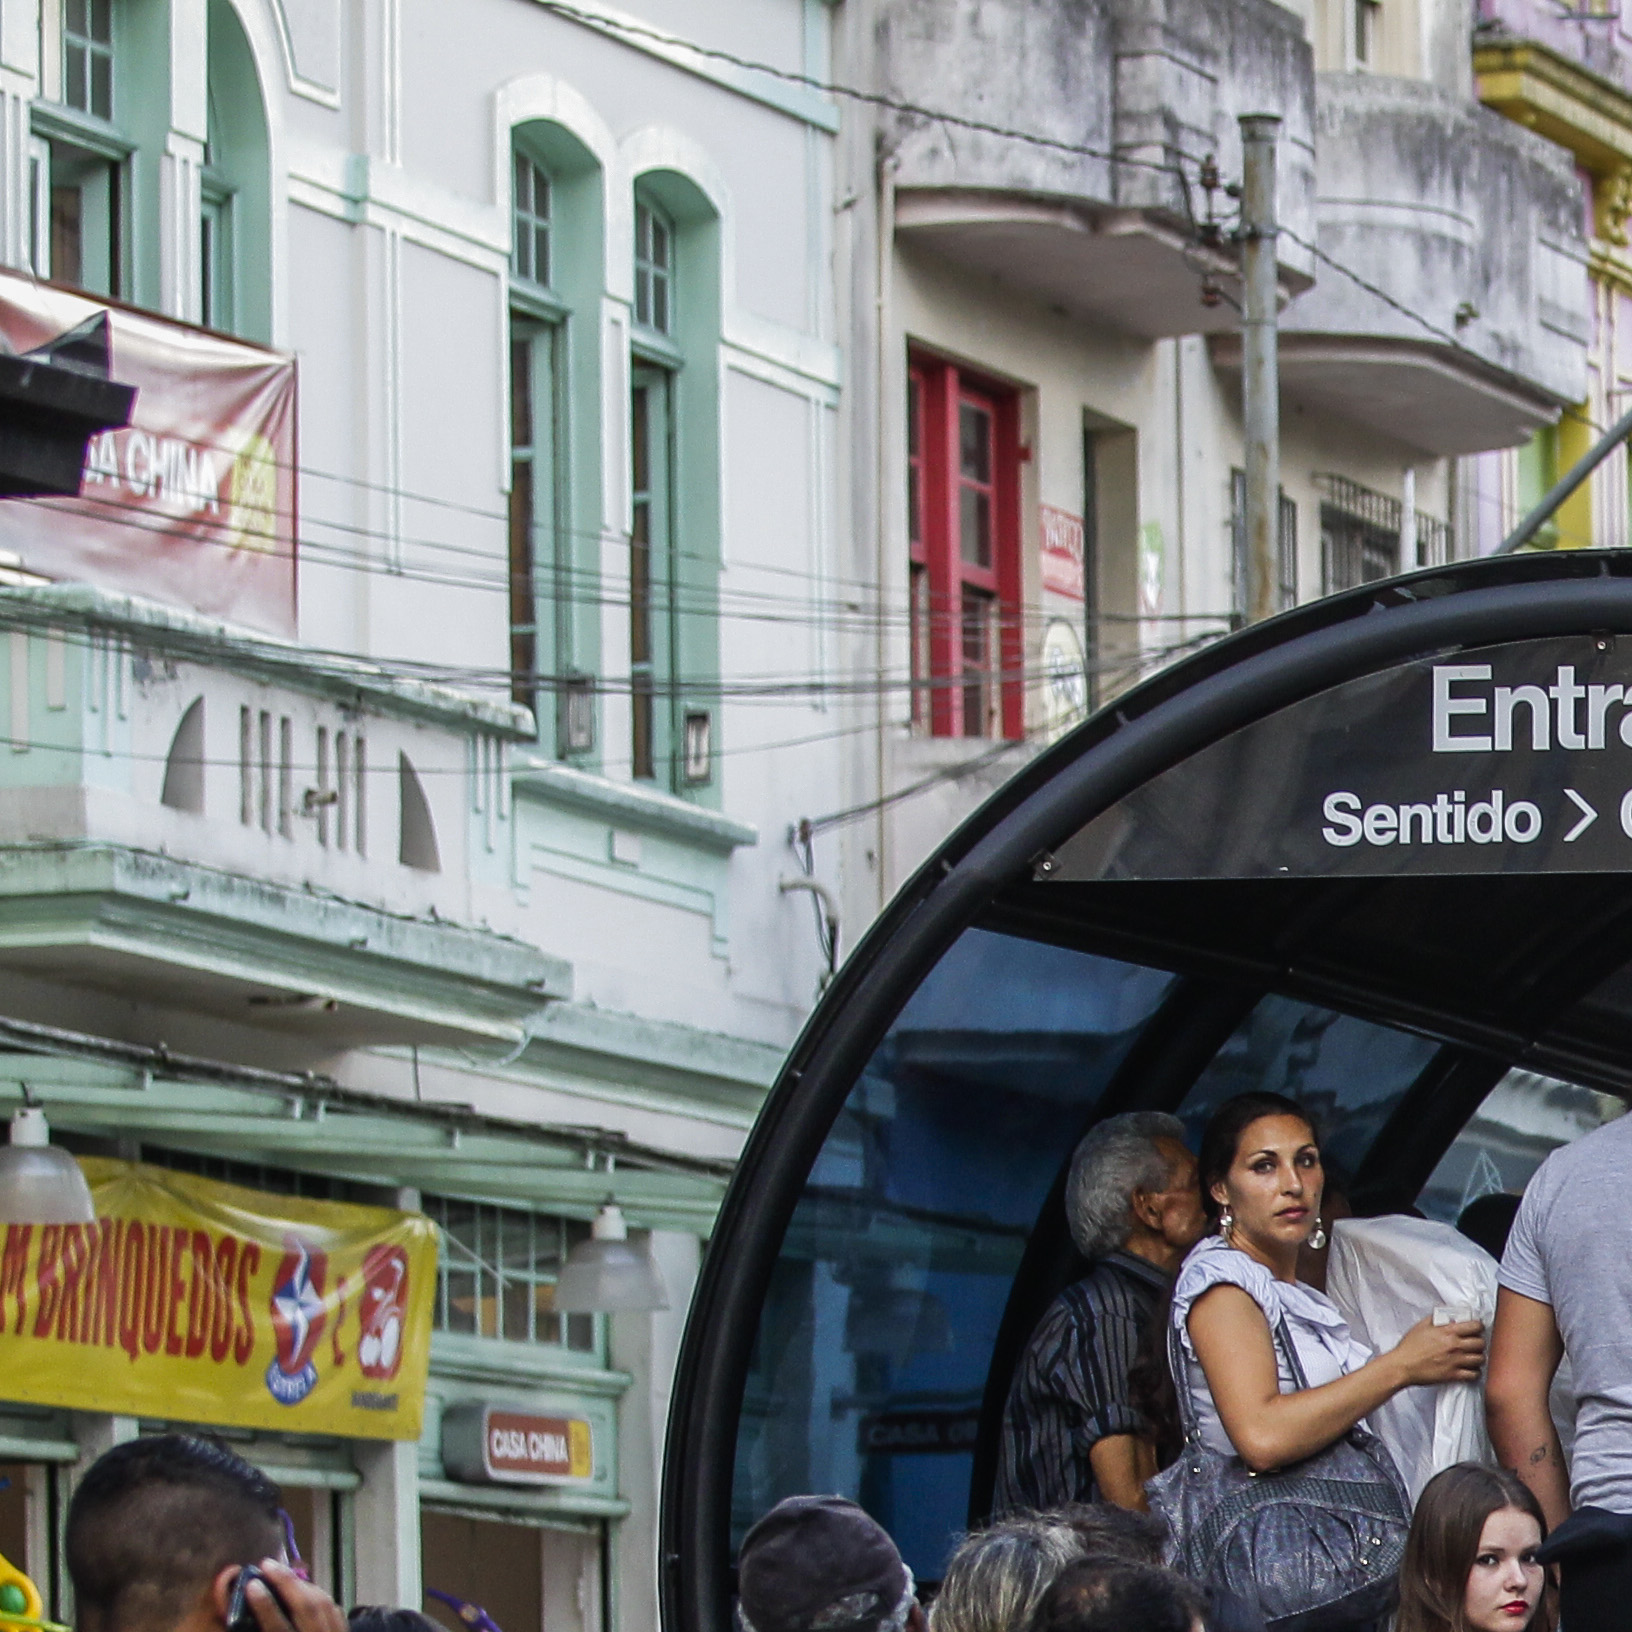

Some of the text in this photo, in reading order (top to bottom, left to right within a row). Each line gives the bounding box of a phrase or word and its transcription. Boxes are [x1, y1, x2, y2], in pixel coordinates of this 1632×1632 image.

[127, 430, 219, 515] CHINA
[1322, 790, 1542, 846] Sentido
[33, 1217, 260, 1367] BRINQUEDOS
[491, 1428, 528, 1460] CASA
[530, 1430, 568, 1463] CHINA
